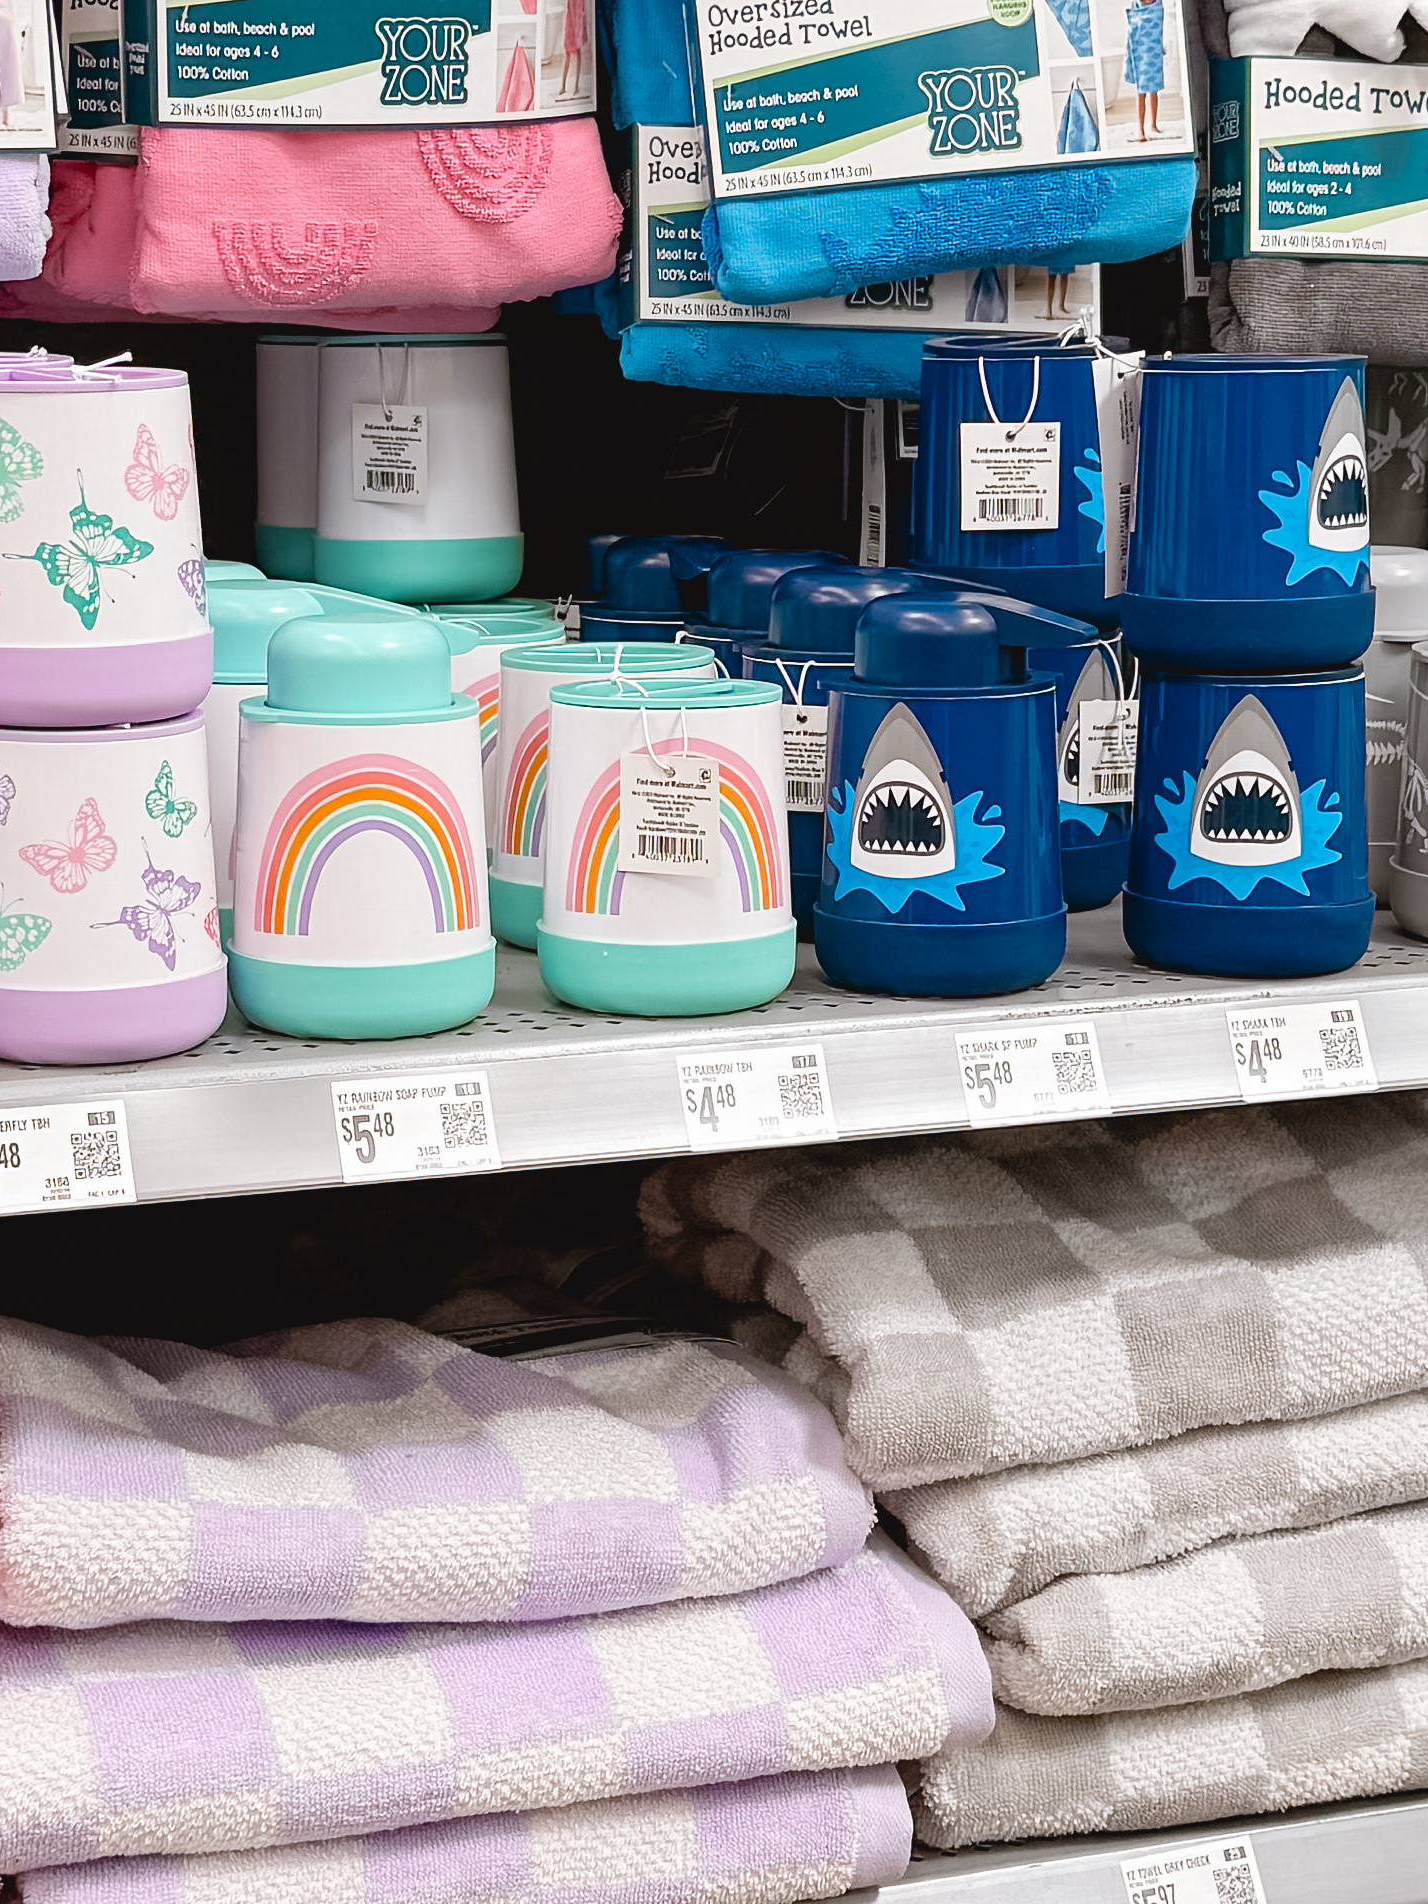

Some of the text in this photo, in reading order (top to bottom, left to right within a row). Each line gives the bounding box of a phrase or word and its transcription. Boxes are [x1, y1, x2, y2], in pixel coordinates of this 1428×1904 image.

[384, 25, 464, 61] YOUR
[710, 16, 873, 55] Hooded Towel
[384, 64, 464, 102] ZONE
[927, 72, 1017, 111] YOUR
[1264, 78, 1361, 112] Hooded
[933, 111, 1018, 152] ZONE
